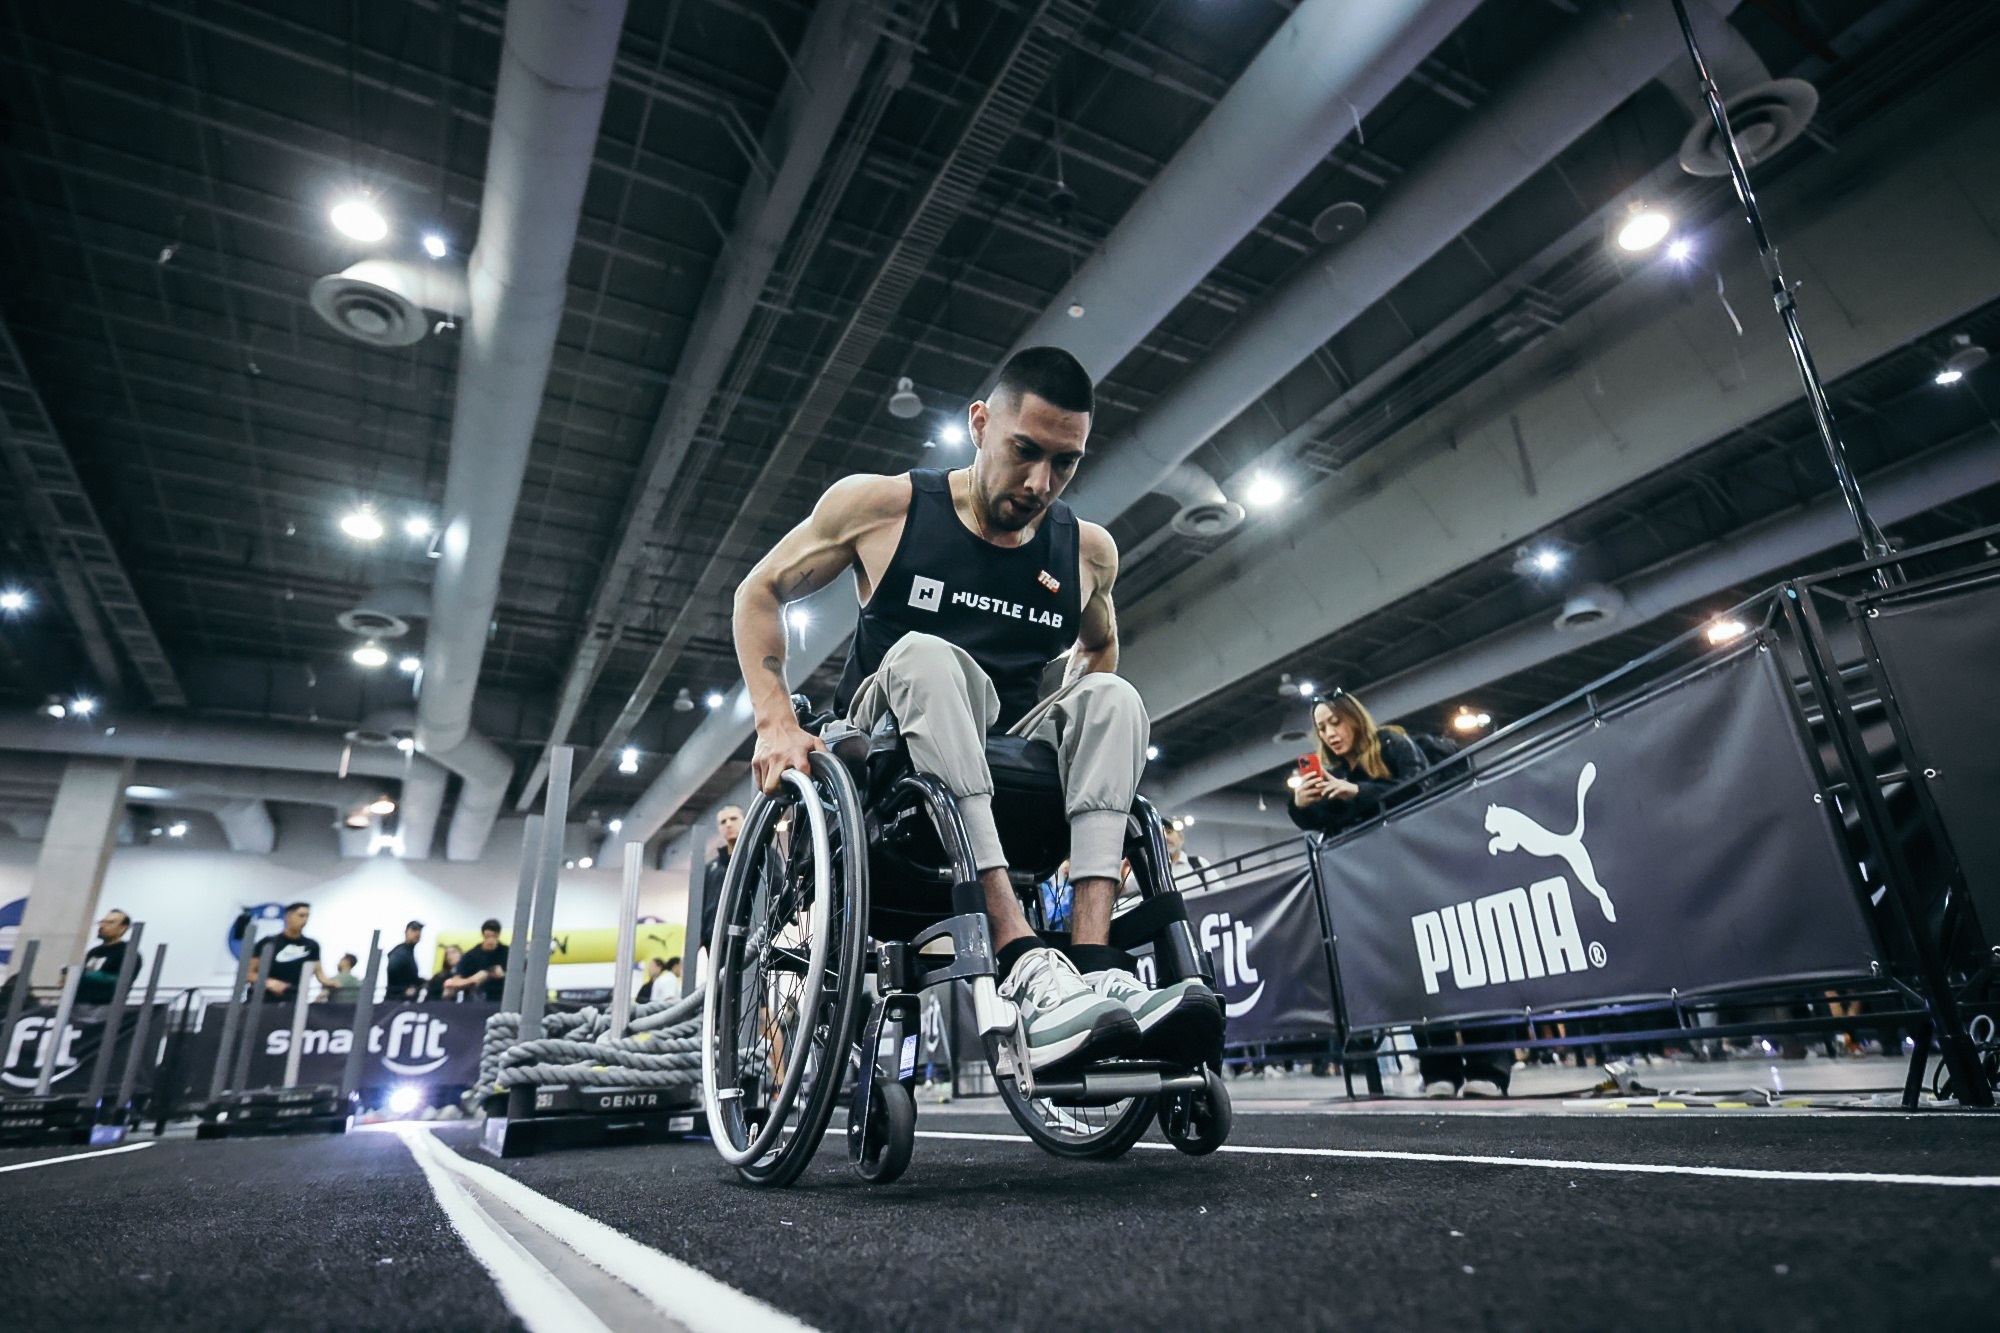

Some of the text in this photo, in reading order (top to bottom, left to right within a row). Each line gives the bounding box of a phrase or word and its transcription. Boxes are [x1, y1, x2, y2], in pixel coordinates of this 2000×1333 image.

[951, 591, 1064, 629] HUSTLE LAB
[1200, 912, 1259, 987] fit
[3, 1016, 83, 1068] fit
[265, 1011, 449, 1059] smat fit
[600, 1094, 658, 1108] CENTR
